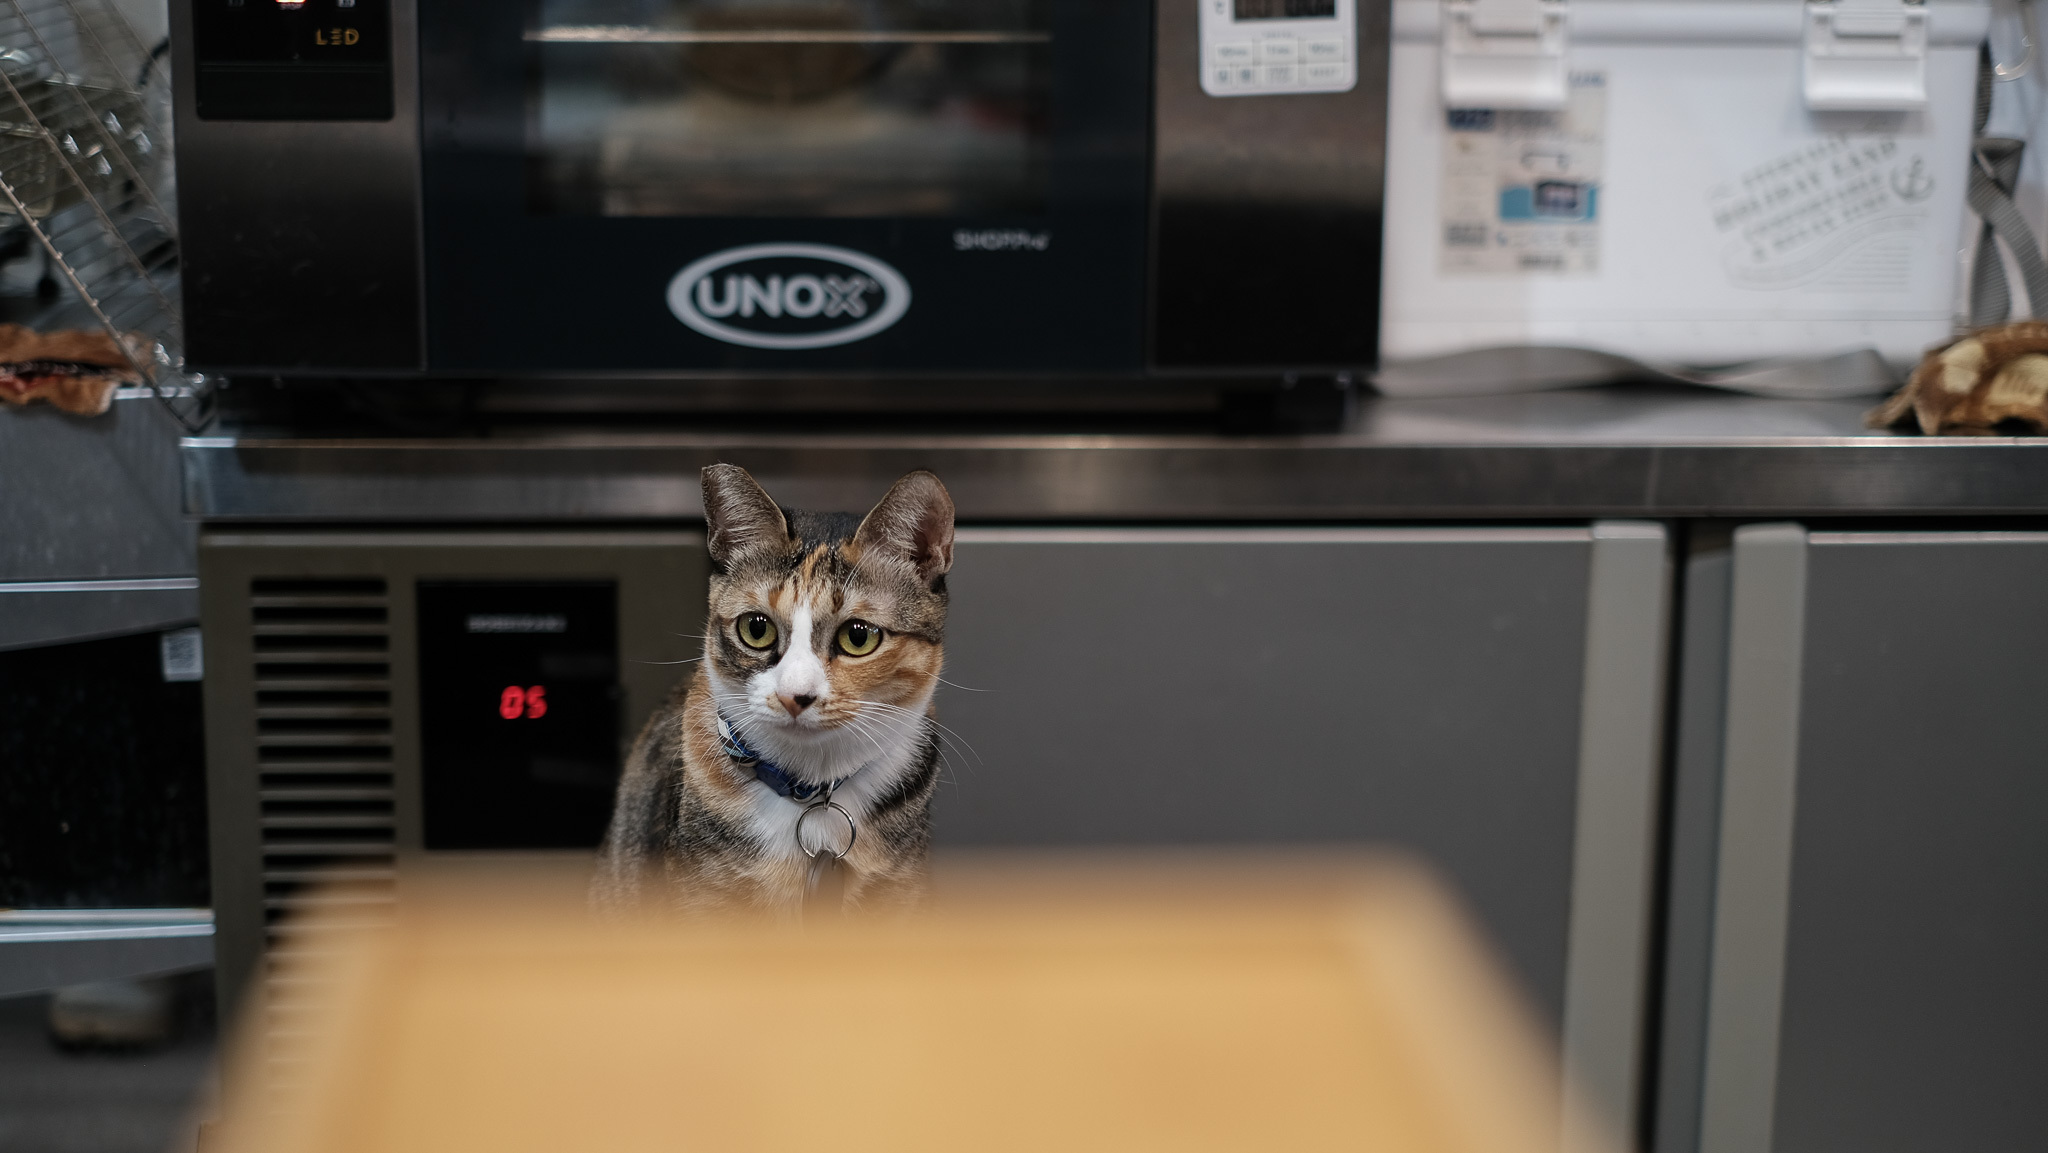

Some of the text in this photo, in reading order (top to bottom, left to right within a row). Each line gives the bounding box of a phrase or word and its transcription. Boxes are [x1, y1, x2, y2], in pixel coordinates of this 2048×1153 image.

[316, 28, 359, 45] LED
[698, 273, 868, 318] UNOX
[500, 685, 548, 719] 05
